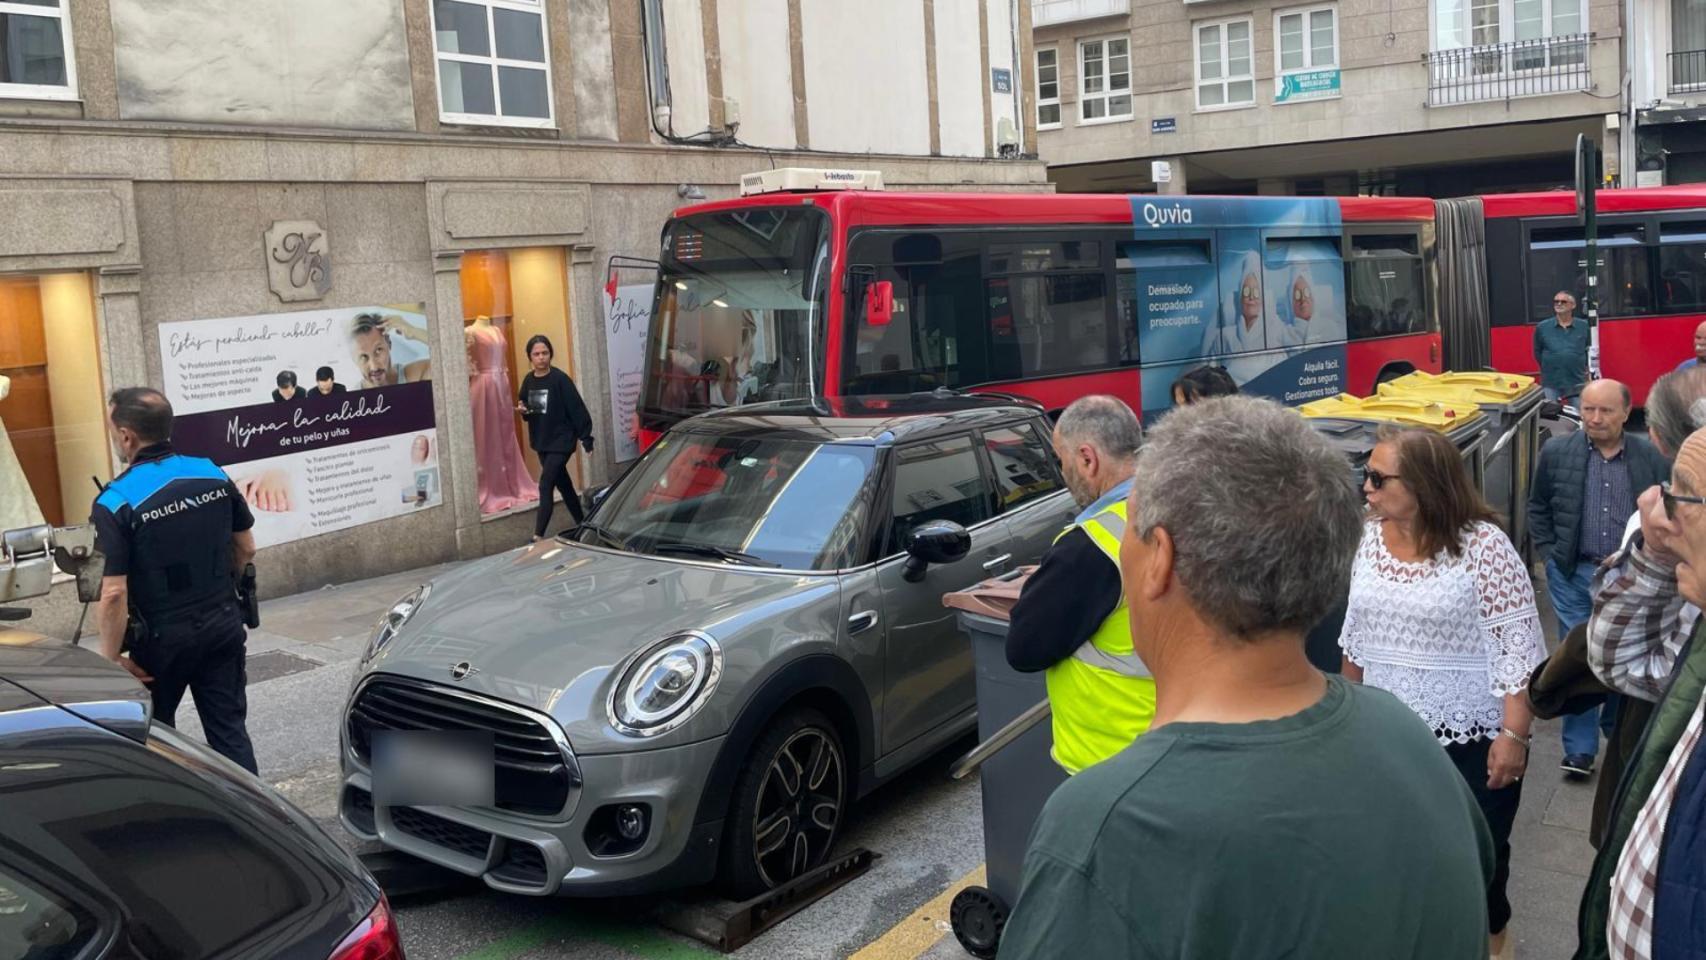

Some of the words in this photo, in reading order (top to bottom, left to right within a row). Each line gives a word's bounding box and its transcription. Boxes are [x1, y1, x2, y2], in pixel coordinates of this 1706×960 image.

[1143, 203, 1192, 228] Quvia
[1148, 284, 1193, 296] Demasiado
[1149, 299, 1185, 313] ocupado
[1186, 300, 1203, 311] para
[1150, 315, 1201, 330] preocuparte.
[188, 359, 231, 369] Profesionales
[232, 355, 277, 364] especializados
[1304, 361, 1324, 373] Alquila
[202, 380, 228, 389] mejores
[1298, 375, 1316, 386] Cobra
[1317, 374, 1339, 384] seguro.
[191, 391, 217, 400] Mejoras
[227, 387, 251, 396] aspecto
[1285, 388, 1324, 400] Gestionamos
[293, 408, 320, 428] la
[325, 394, 391, 423] calidad
[280, 435, 291, 446] de
[292, 434, 302, 444] tu
[303, 432, 322, 445] pelo
[324, 432, 330, 442] y
[331, 427, 350, 438] uñas
[141, 499, 188, 523] POLICÍA
[195, 488, 228, 505] LOCAL
